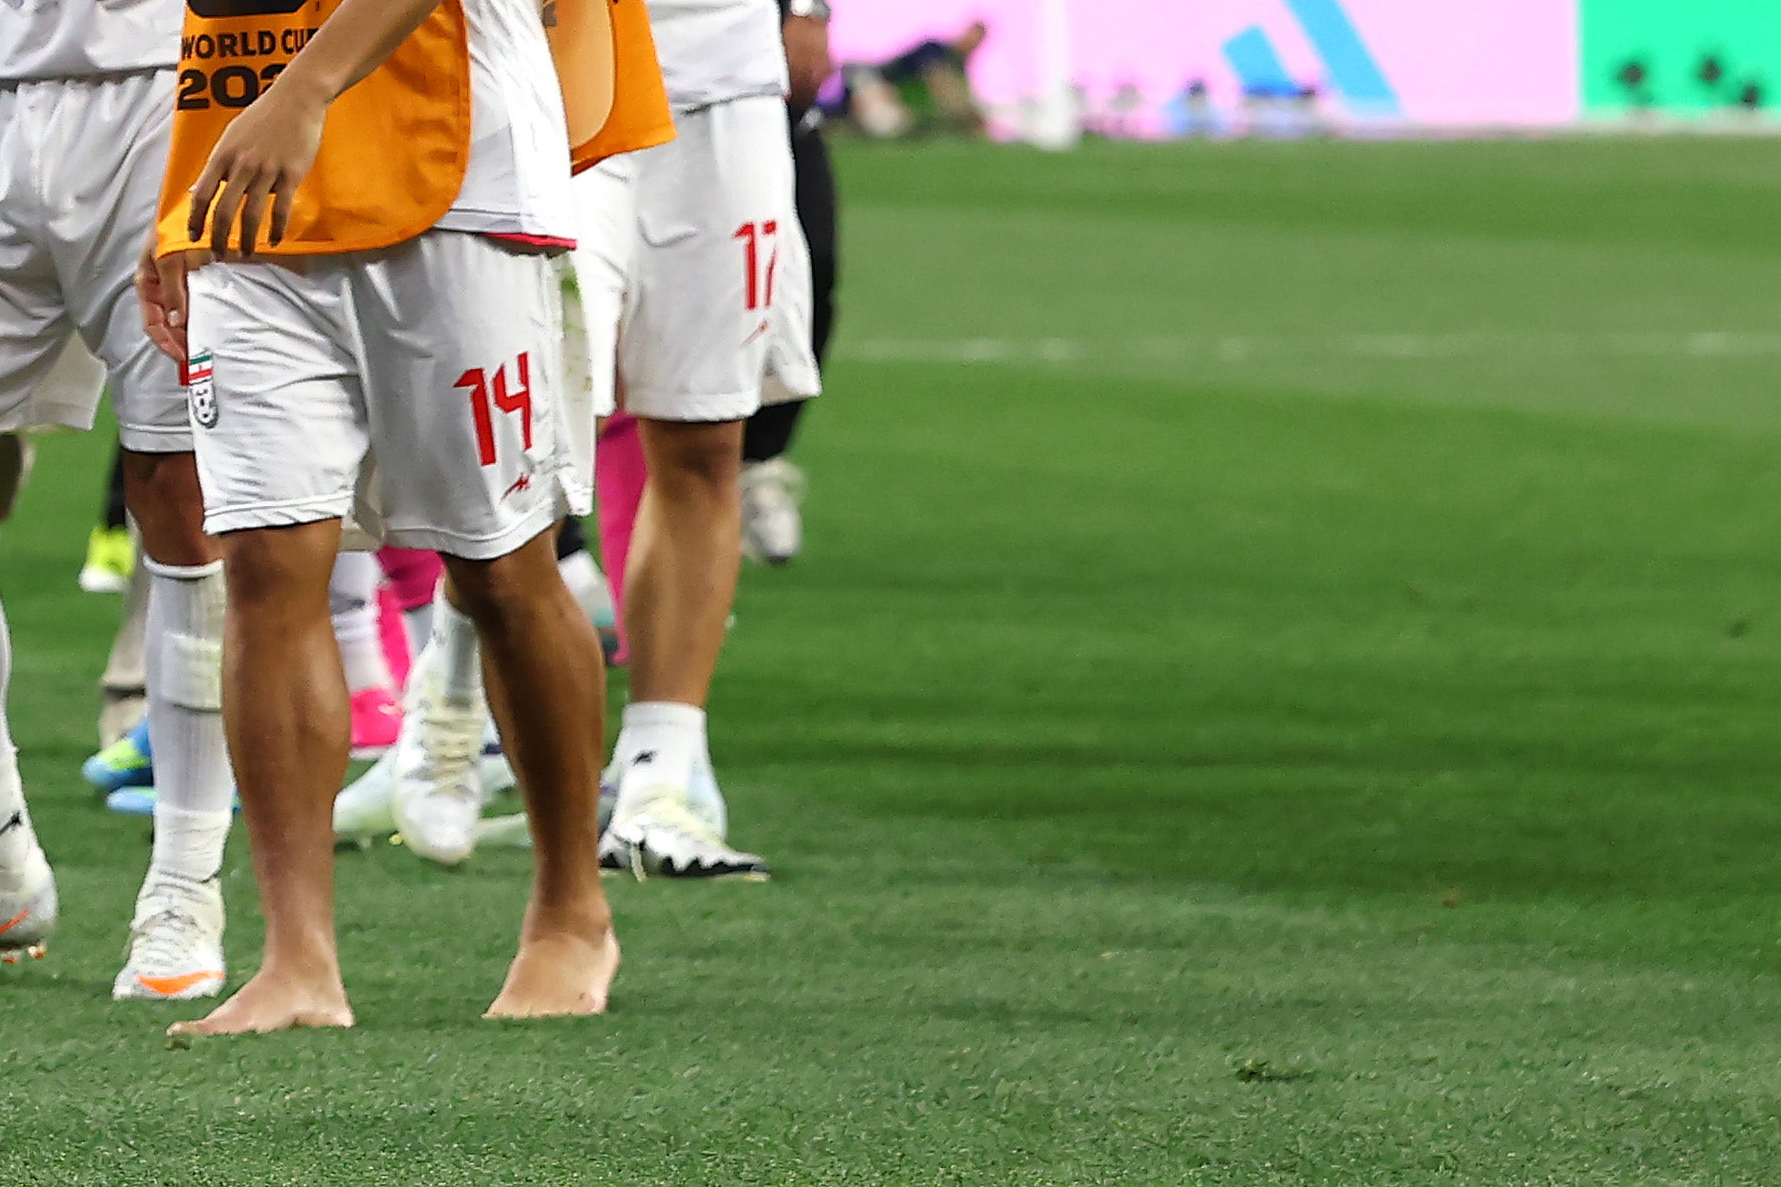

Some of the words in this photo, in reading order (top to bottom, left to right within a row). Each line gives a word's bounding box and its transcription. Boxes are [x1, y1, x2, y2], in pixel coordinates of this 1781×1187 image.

[181, 29, 276, 60] WORLD
[732, 220, 778, 311] 17
[453, 351, 533, 466] 14
